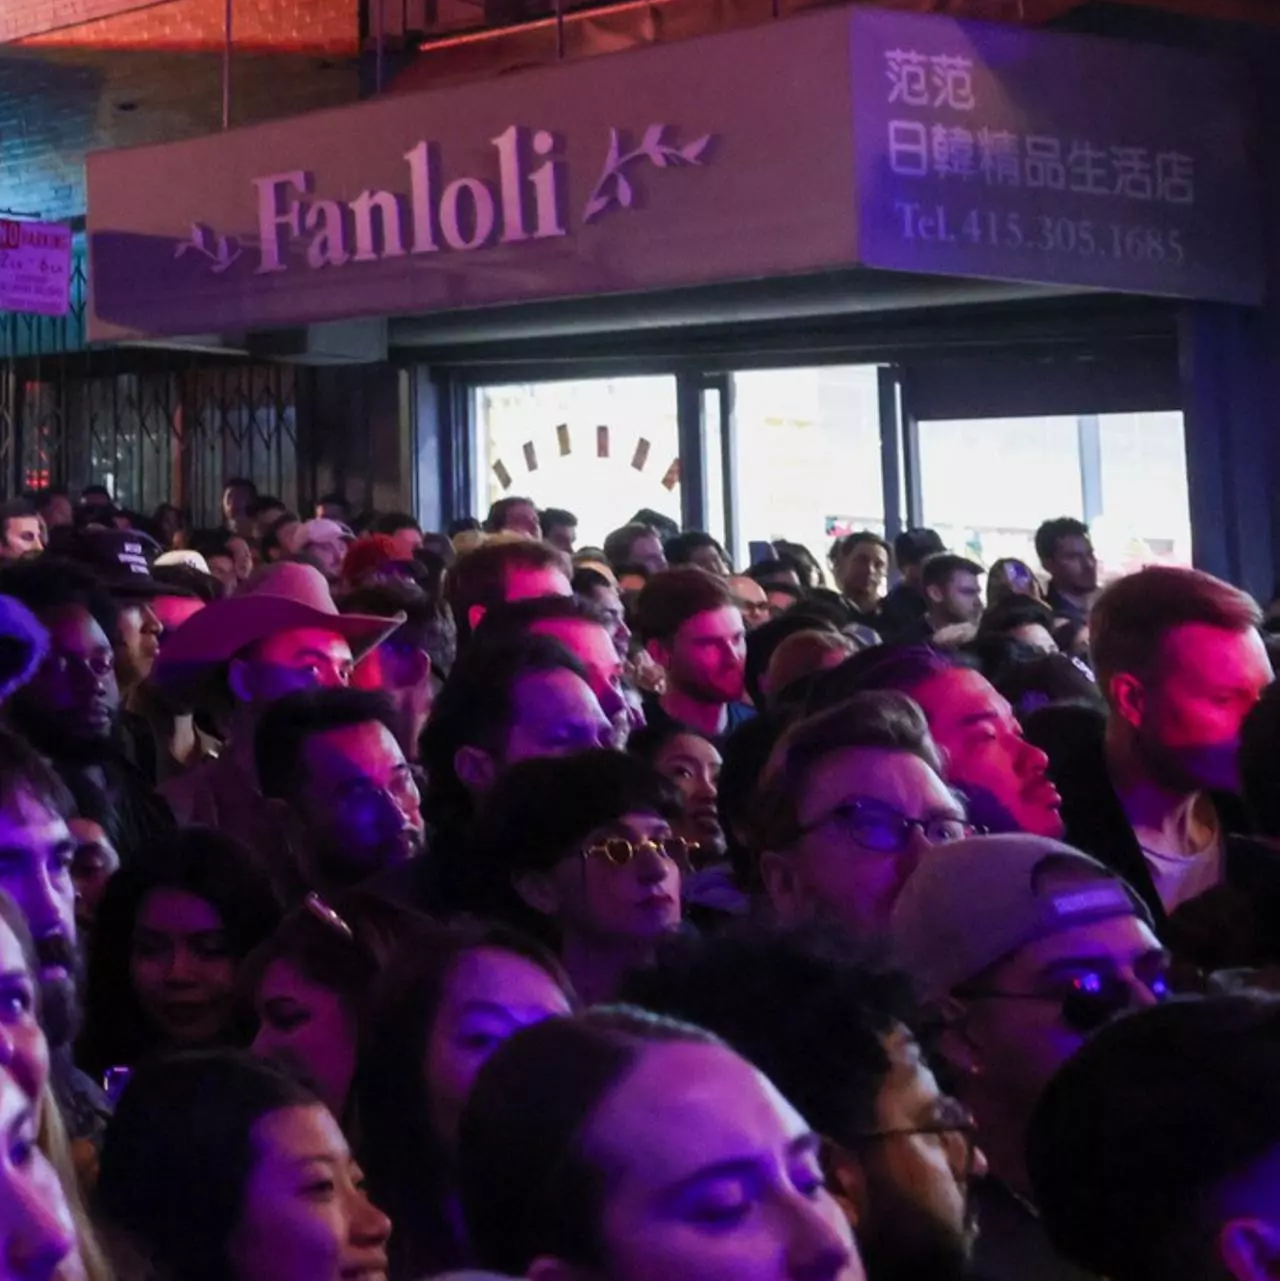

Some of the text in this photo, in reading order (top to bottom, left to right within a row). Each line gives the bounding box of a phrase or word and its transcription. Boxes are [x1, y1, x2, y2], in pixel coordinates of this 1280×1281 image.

[252, 124, 567, 275] Fanloli
[888, 119, 1195, 205] 日韓精品生活店
